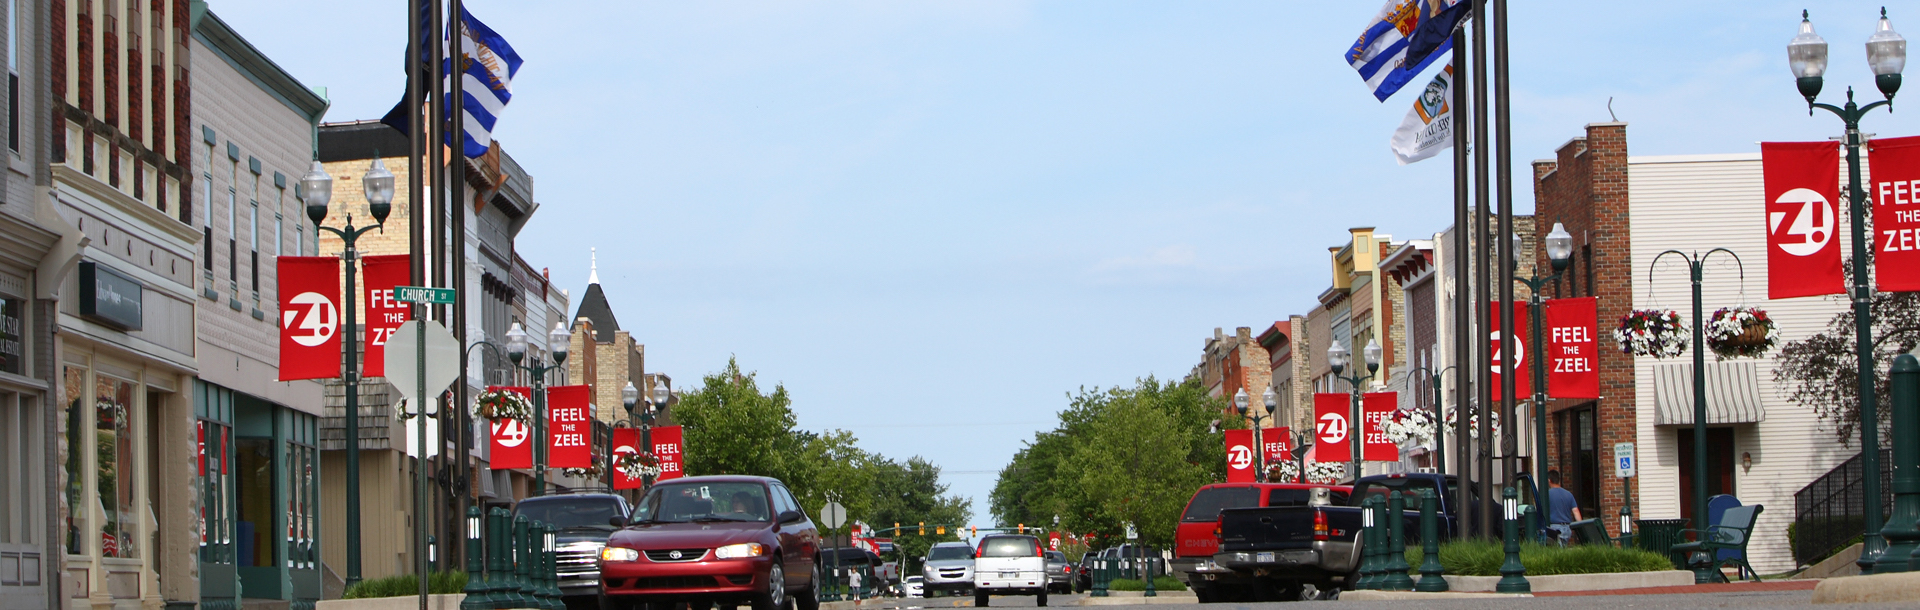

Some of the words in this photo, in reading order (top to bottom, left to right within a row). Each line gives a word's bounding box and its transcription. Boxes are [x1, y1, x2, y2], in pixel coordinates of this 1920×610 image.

[401, 288, 435, 302] CHURCH
[384, 312, 404, 323] THE
[1552, 326, 1592, 343] FEEL
[1562, 346, 1579, 355] THE
[1554, 357, 1592, 373] ZEEL
[552, 407, 586, 422] FEEL
[561, 424, 576, 432] THE
[554, 433, 586, 447] ZEEL
[655, 443, 680, 455] FEEL
[1265, 441, 1288, 453] FEEL
